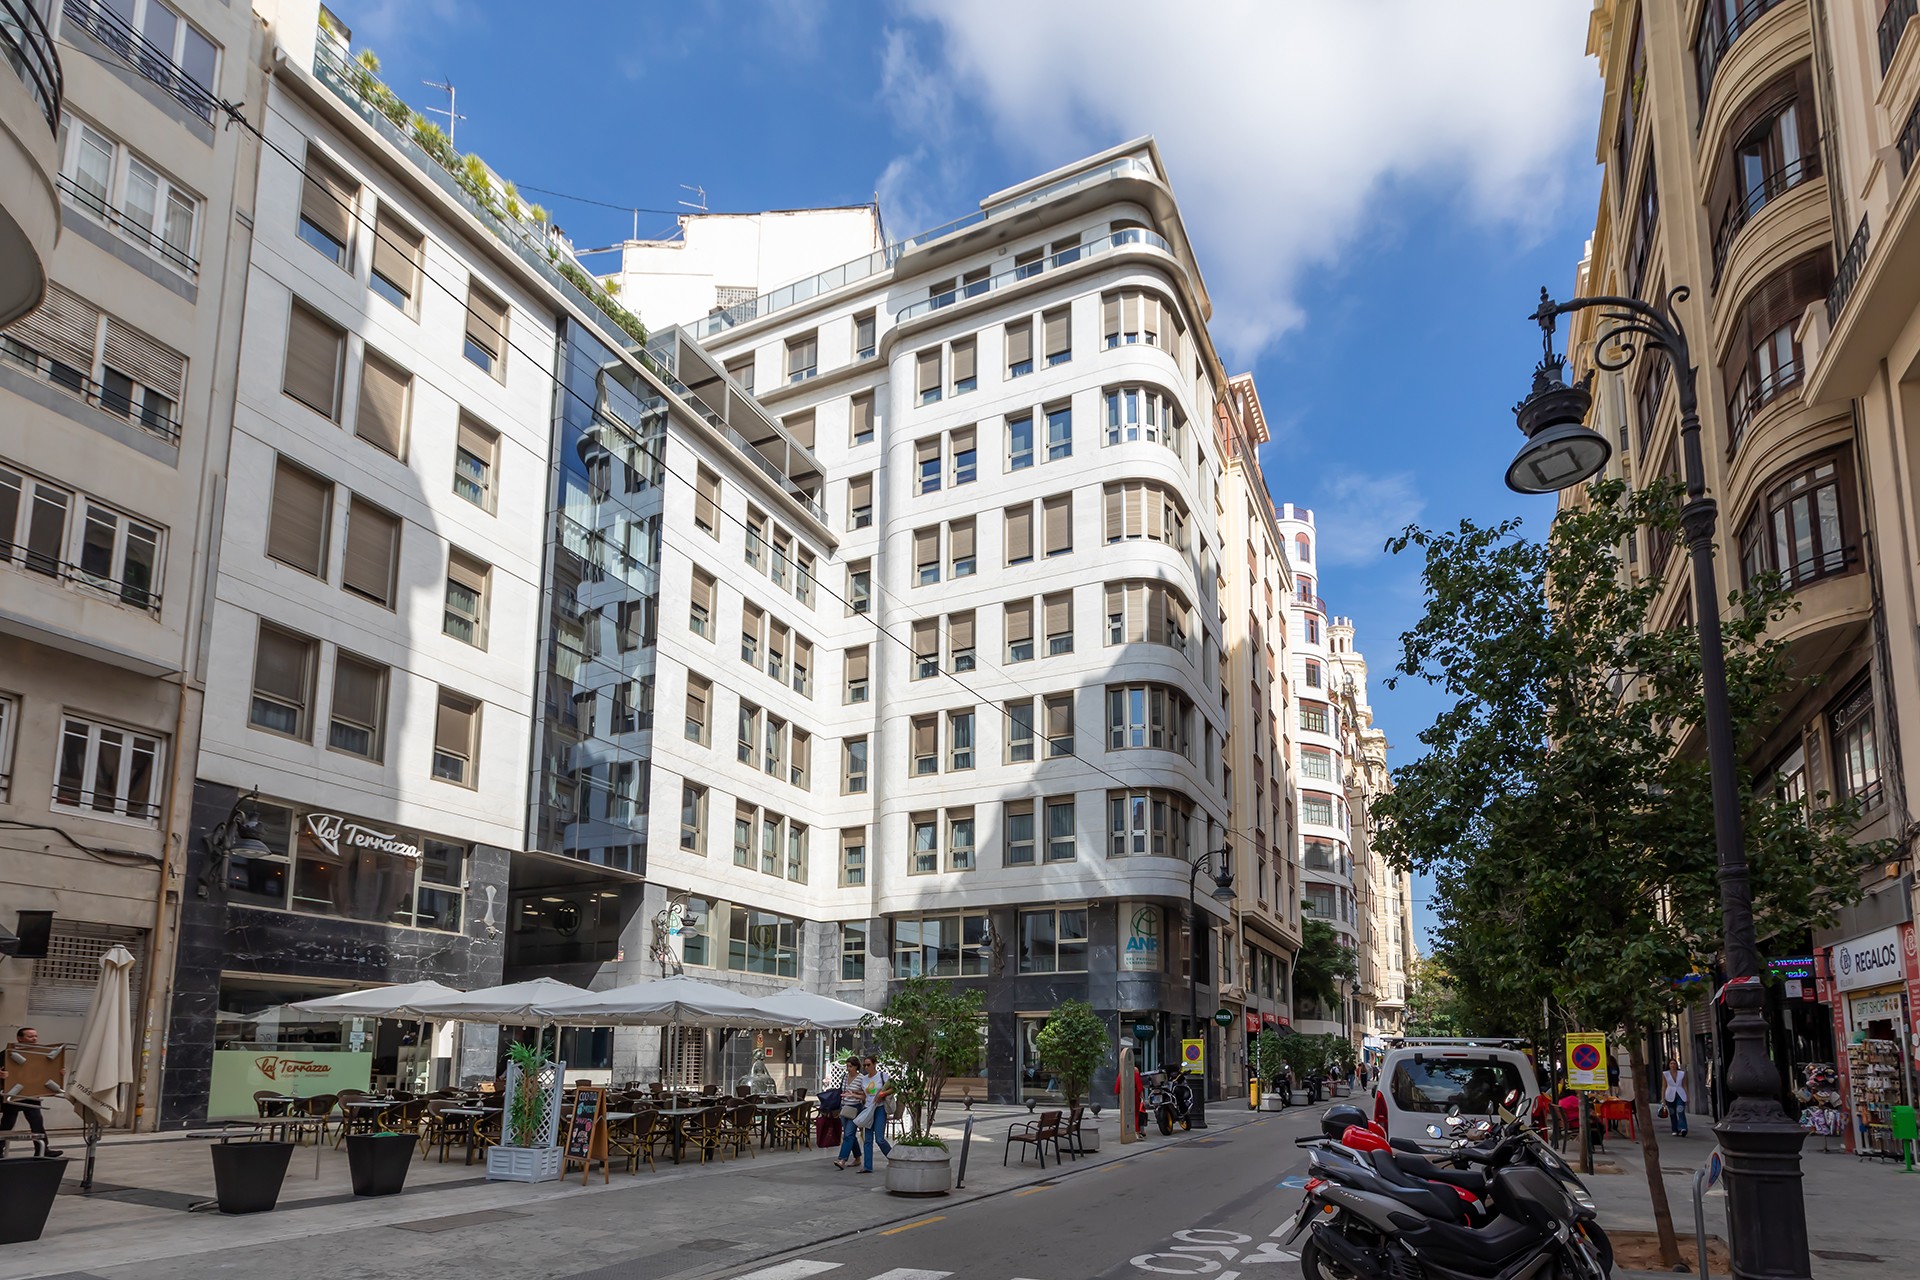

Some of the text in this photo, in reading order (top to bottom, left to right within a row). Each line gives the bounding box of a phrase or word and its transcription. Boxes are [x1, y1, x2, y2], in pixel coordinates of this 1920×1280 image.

[344, 823, 421, 858] Terrazza
[1854, 943, 1897, 973] REGALOS
[1856, 999, 1885, 1015] GIFT SHOP
[279, 1059, 331, 1074] Terrazza
